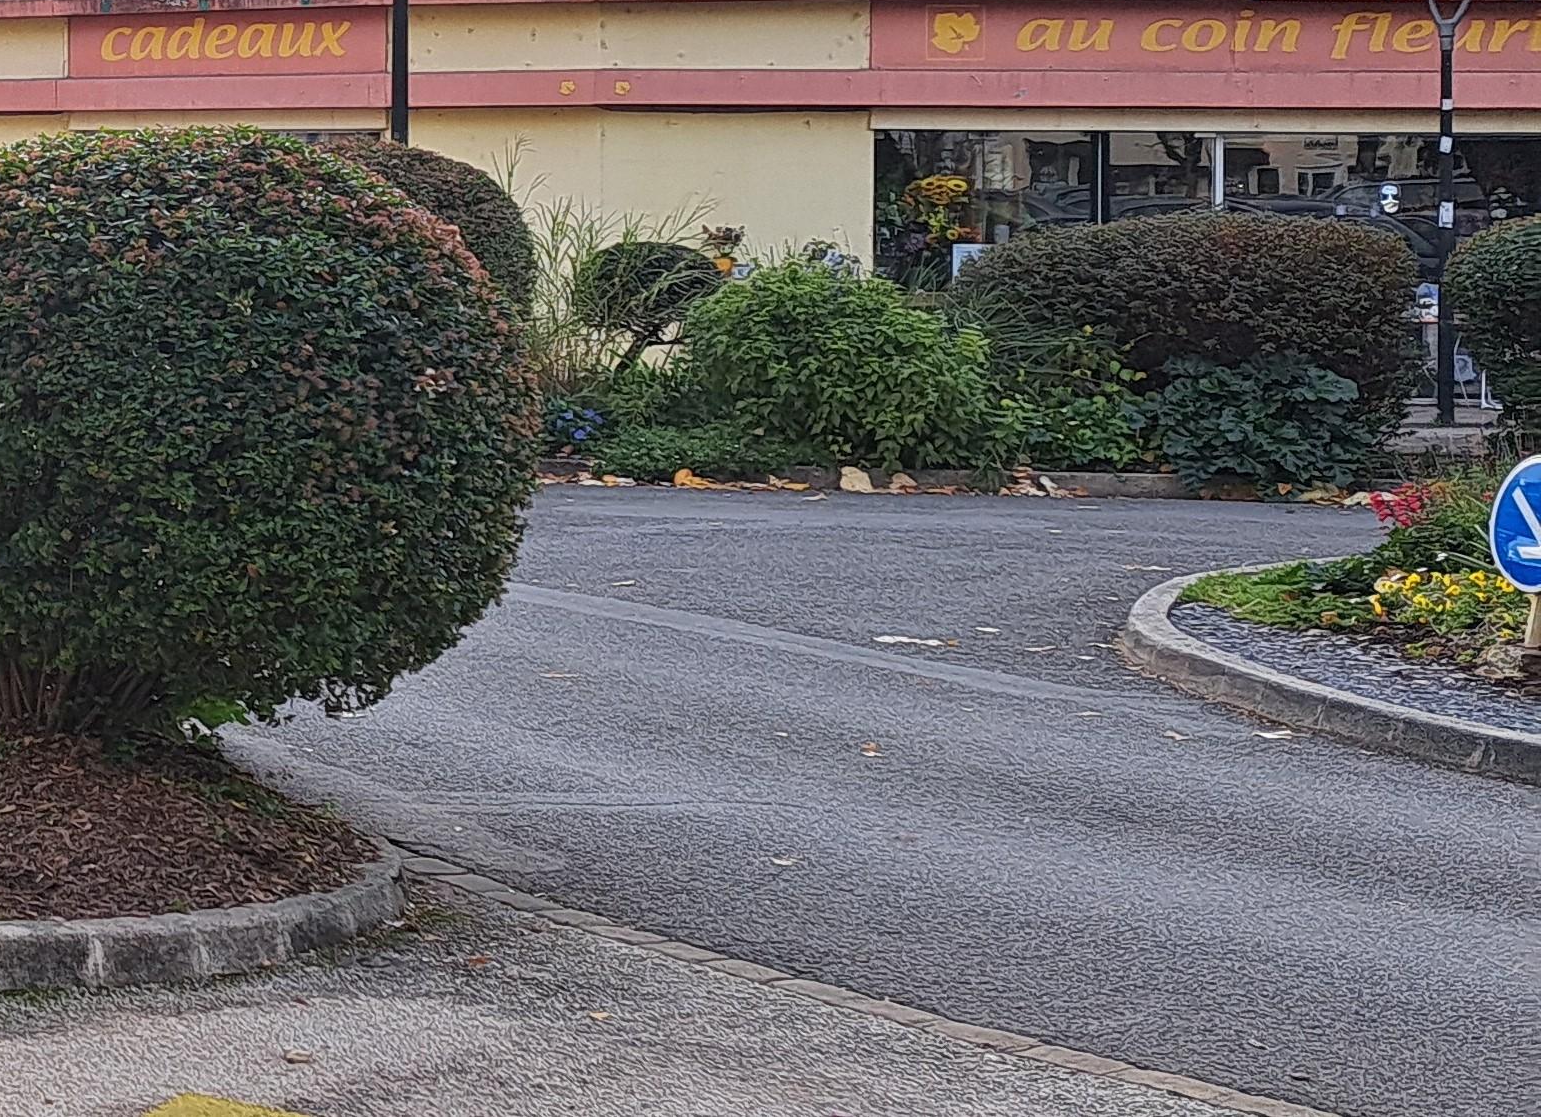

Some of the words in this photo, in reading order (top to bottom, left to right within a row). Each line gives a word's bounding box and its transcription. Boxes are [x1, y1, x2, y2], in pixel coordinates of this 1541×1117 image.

[100, 17, 351, 61] cadeaux
[1016, 12, 1115, 52] au
[1140, 9, 1300, 53] coin
